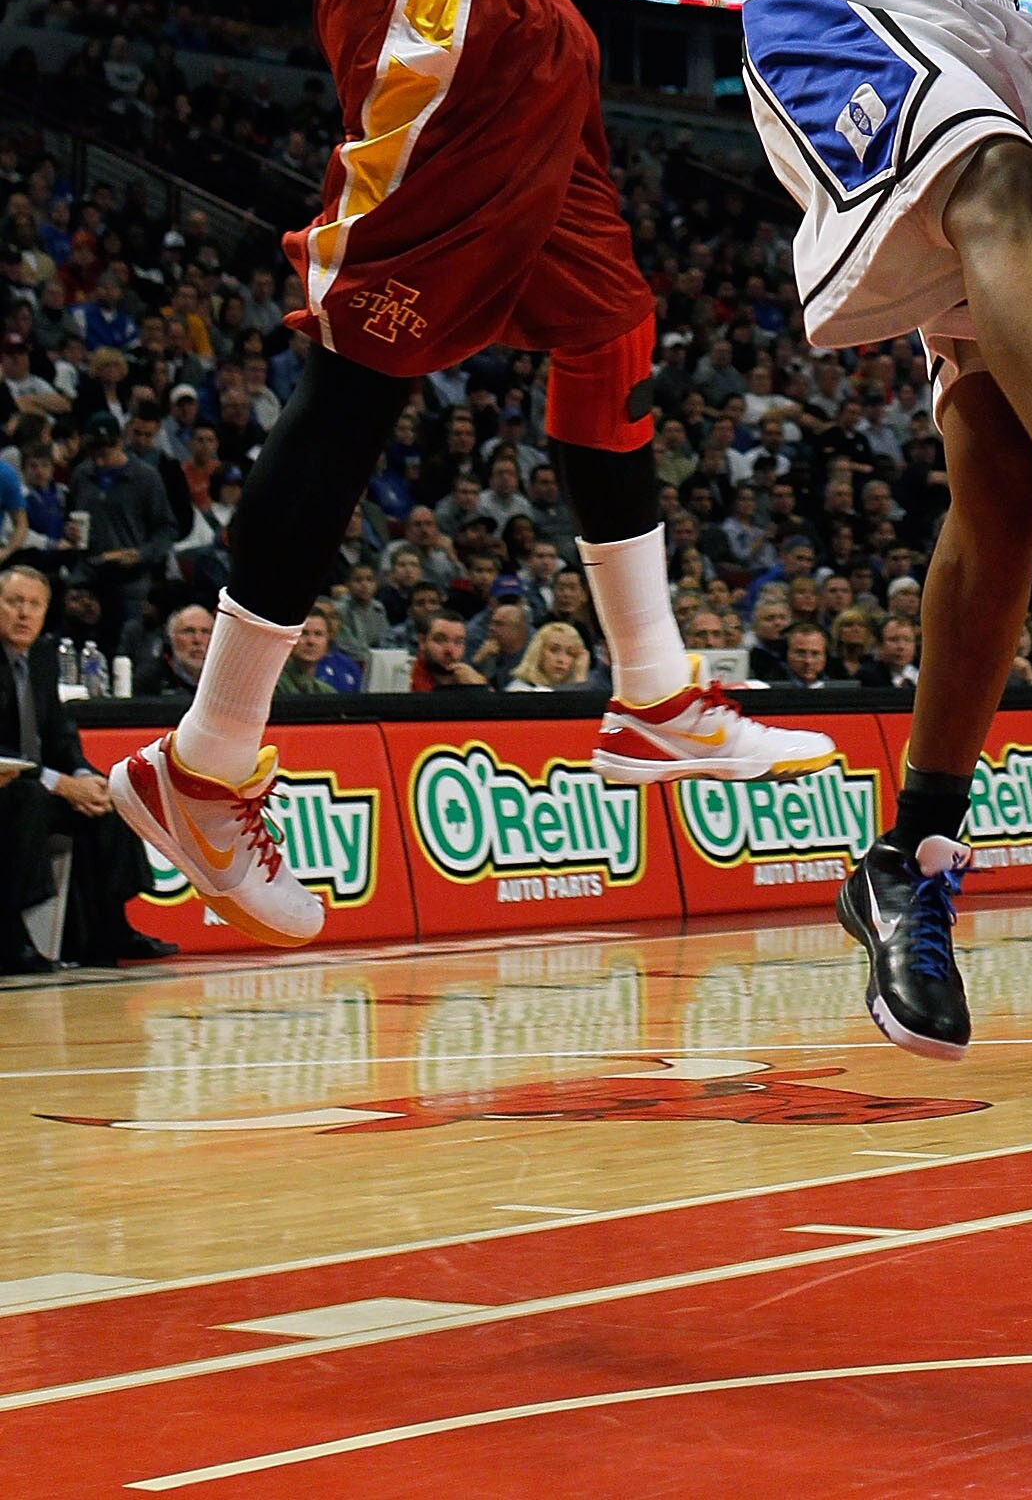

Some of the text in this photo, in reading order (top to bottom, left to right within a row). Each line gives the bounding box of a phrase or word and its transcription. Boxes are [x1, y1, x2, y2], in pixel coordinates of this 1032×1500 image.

[348, 291, 428, 338] STATE
[425, 760, 632, 865] O'Reilly
[688, 778, 868, 851] OReilly
[497, 874, 603, 903] AUTO PARTS
[753, 859, 847, 886] AUTO PARTS
